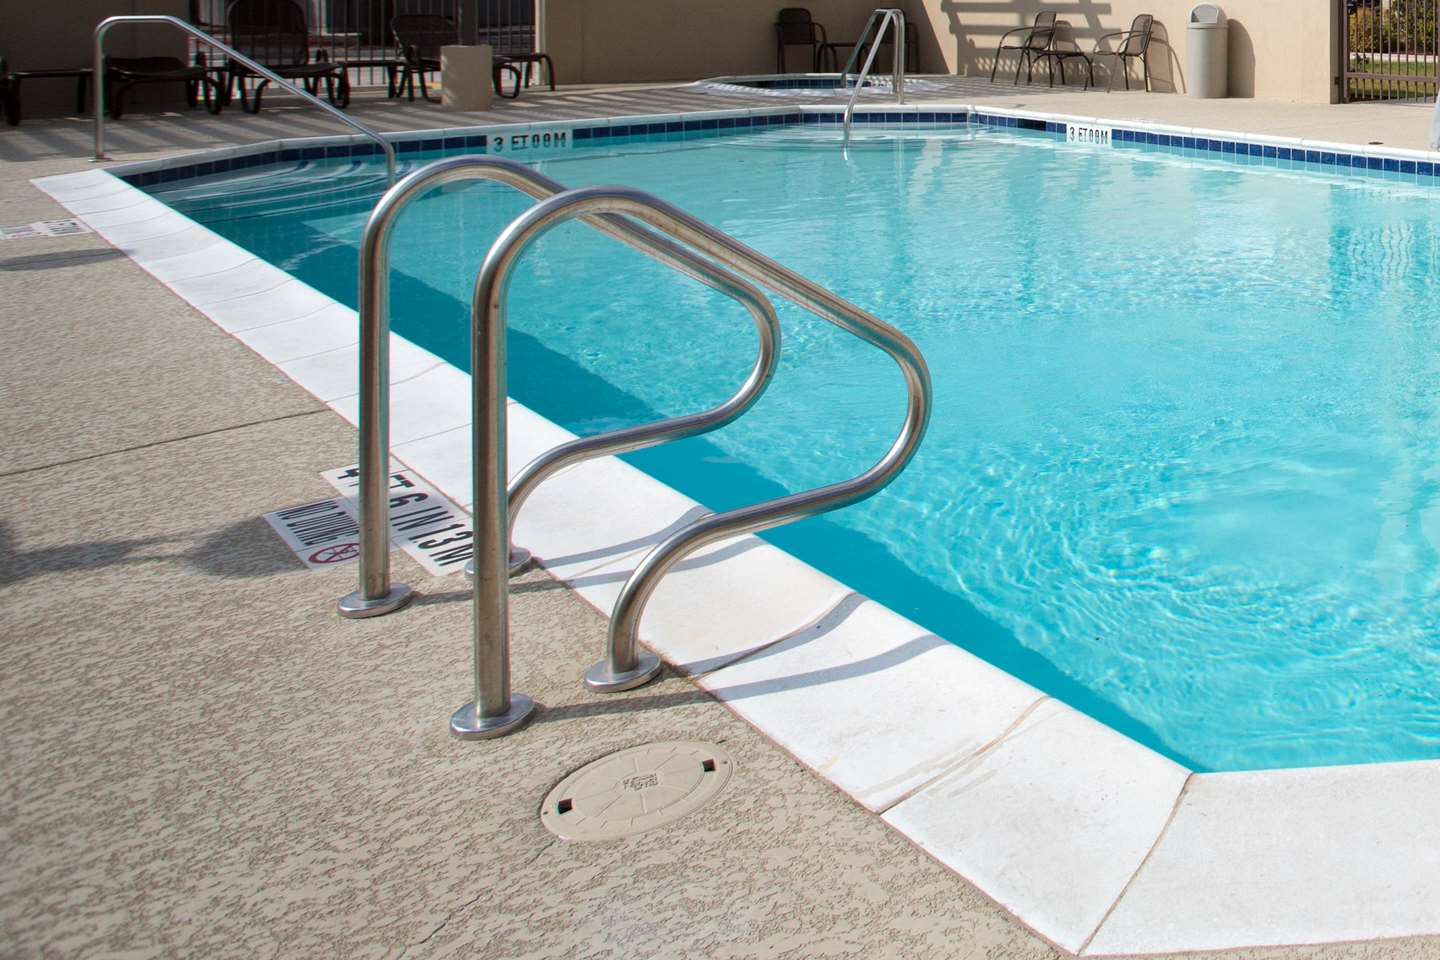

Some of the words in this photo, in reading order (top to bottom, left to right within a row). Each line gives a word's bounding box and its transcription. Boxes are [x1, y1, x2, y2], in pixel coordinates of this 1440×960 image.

[277, 500, 339, 521] NO
[389, 492, 429, 509] 6
[286, 511, 360, 547] DIVING
[389, 505, 455, 531] IN
